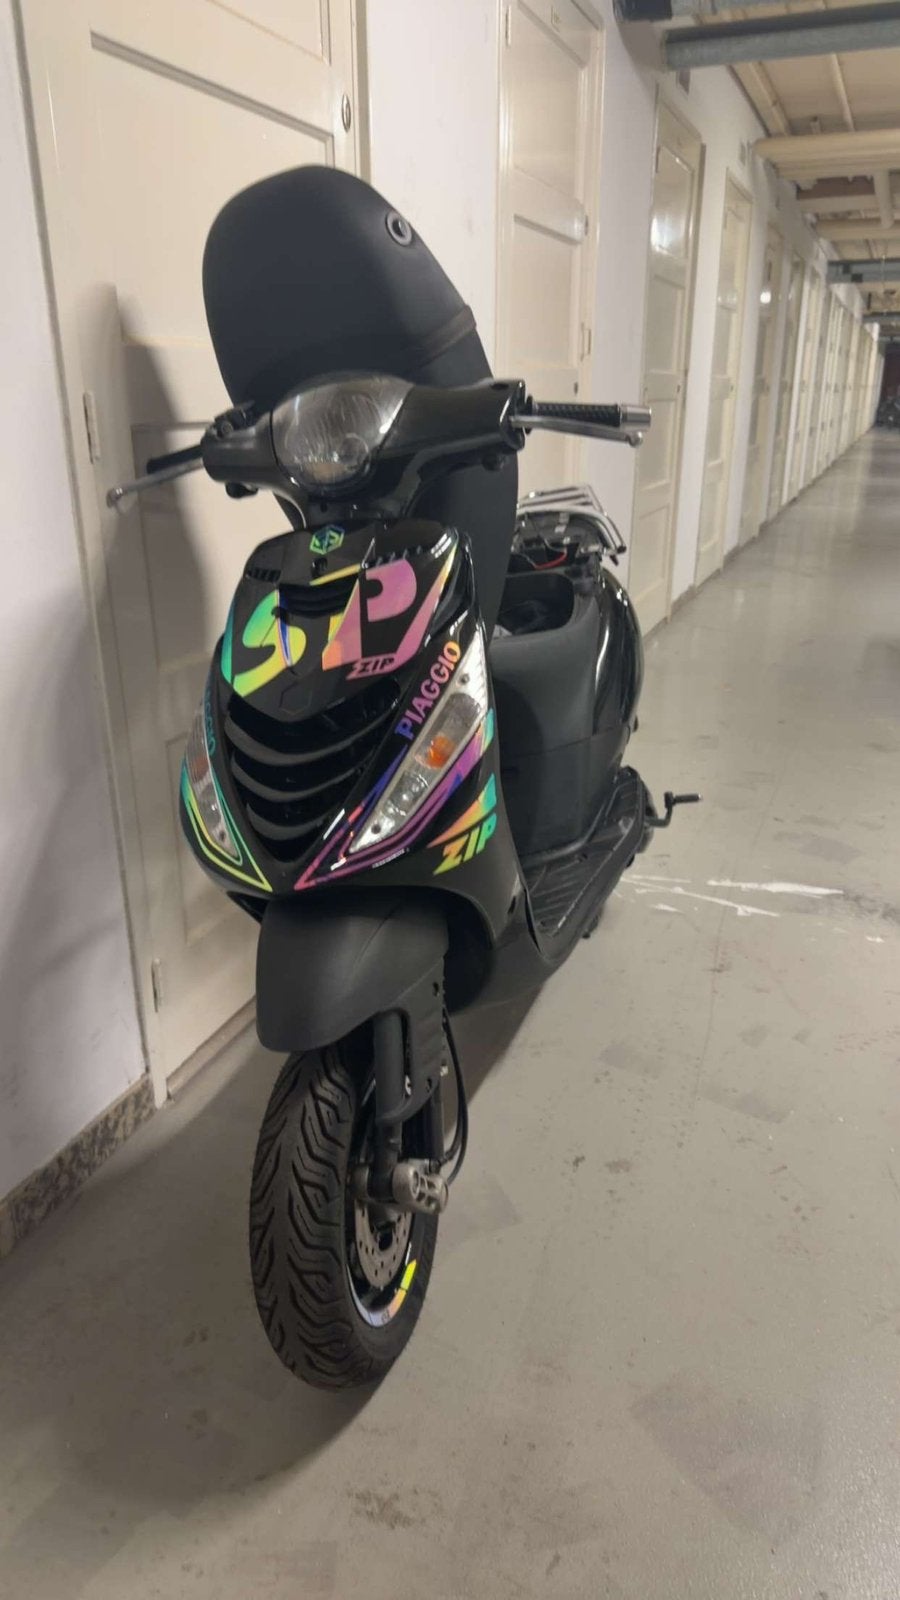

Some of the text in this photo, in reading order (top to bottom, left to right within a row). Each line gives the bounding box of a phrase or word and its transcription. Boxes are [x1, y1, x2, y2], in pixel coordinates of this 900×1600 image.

[358, 656, 395, 675] ZIP
[395, 640, 461, 740] PIAGGIO
[433, 813, 497, 875] ZIP
